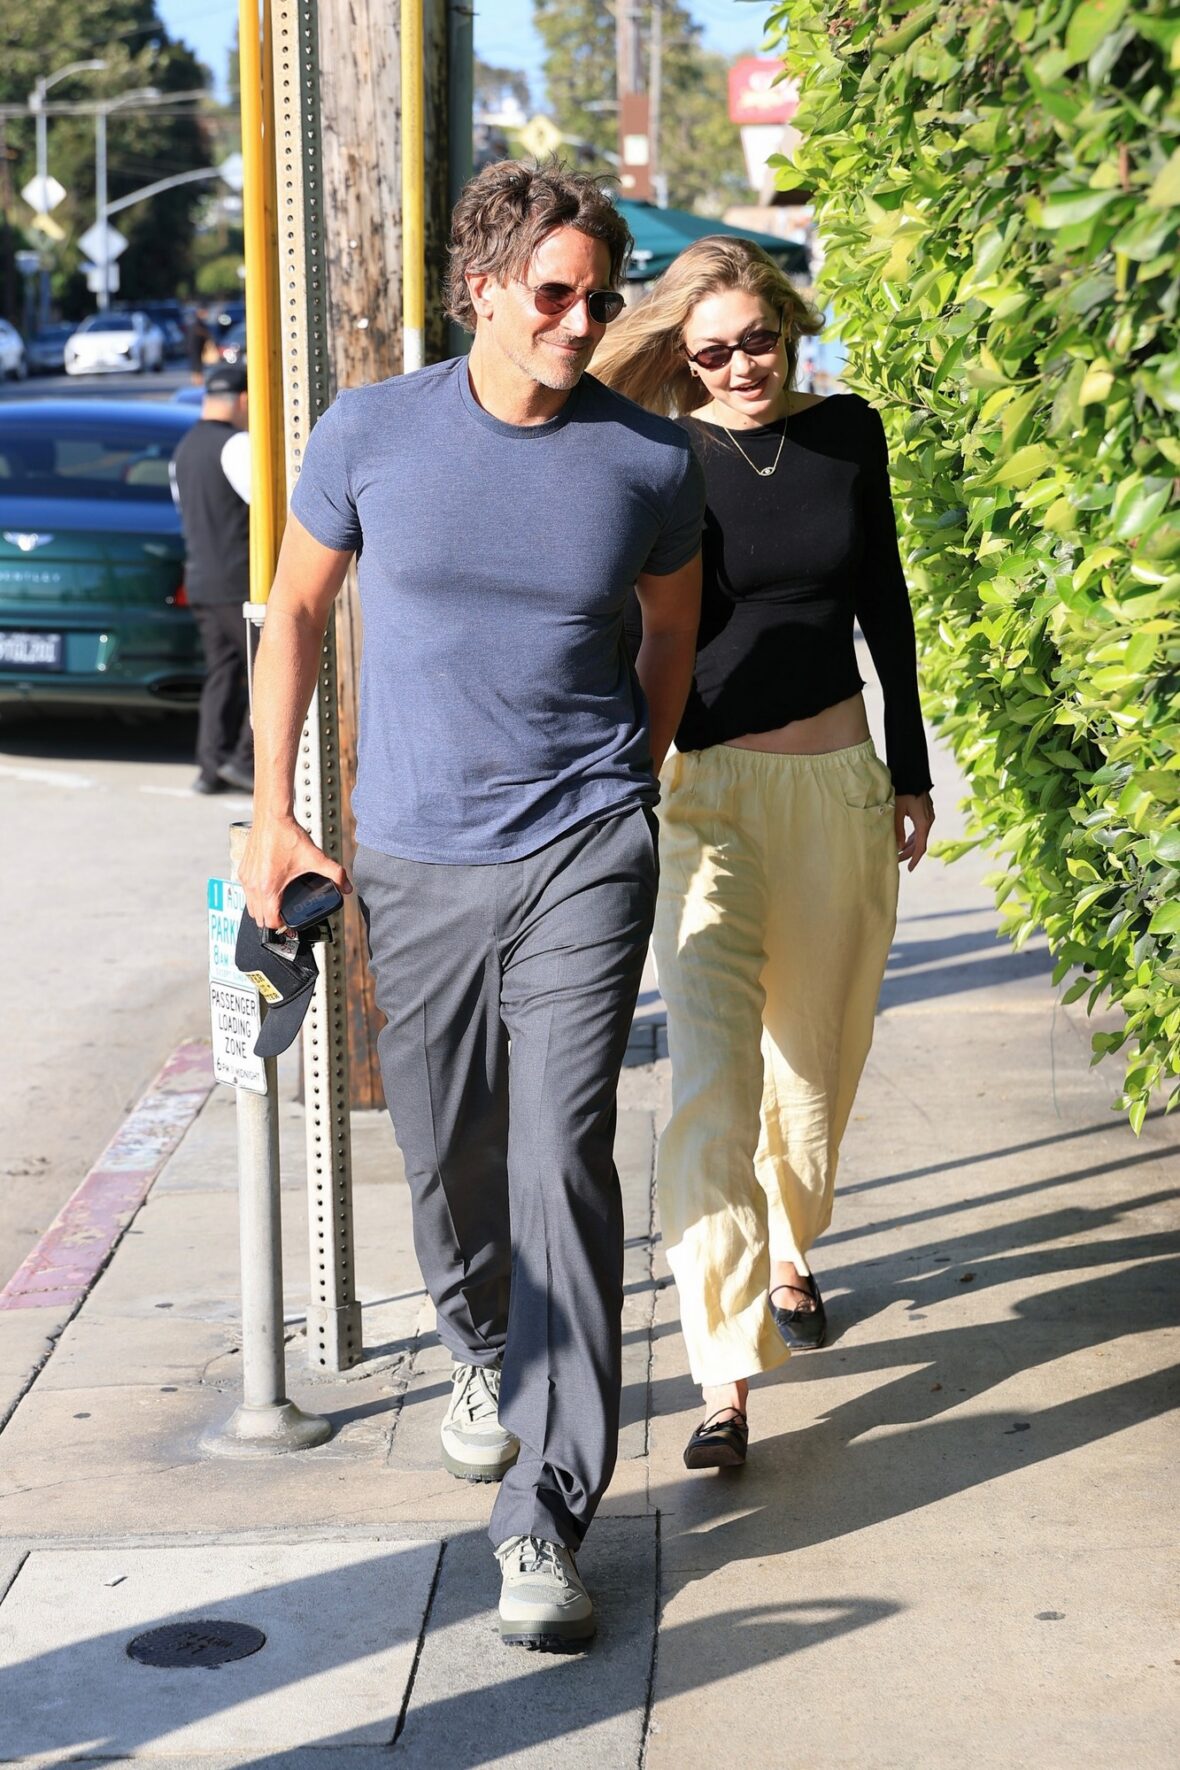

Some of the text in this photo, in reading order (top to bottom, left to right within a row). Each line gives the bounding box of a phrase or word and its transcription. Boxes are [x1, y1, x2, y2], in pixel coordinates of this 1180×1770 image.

[213, 883, 245, 912] 1 HOU
[211, 988, 257, 1017] PASSENGER
[218, 1013, 252, 1038] LOADING
[225, 1036, 247, 1059] ZONE
